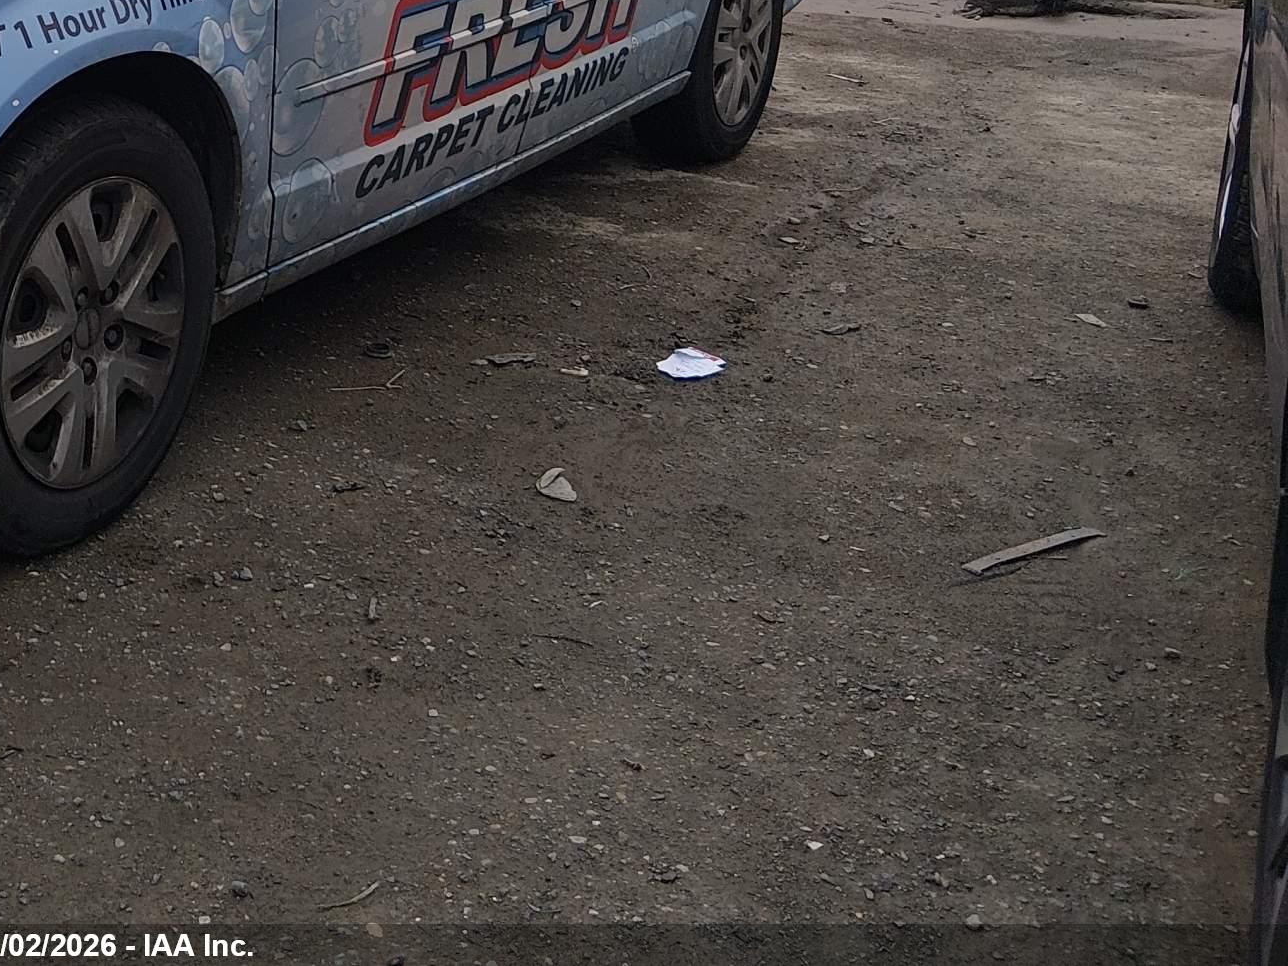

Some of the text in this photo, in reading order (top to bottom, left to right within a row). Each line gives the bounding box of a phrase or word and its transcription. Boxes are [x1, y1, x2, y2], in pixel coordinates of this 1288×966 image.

[14, 20, 33, 49] 1
[37, 6, 107, 44] Hour
[355, 46, 631, 199] CARPET CLEANING
